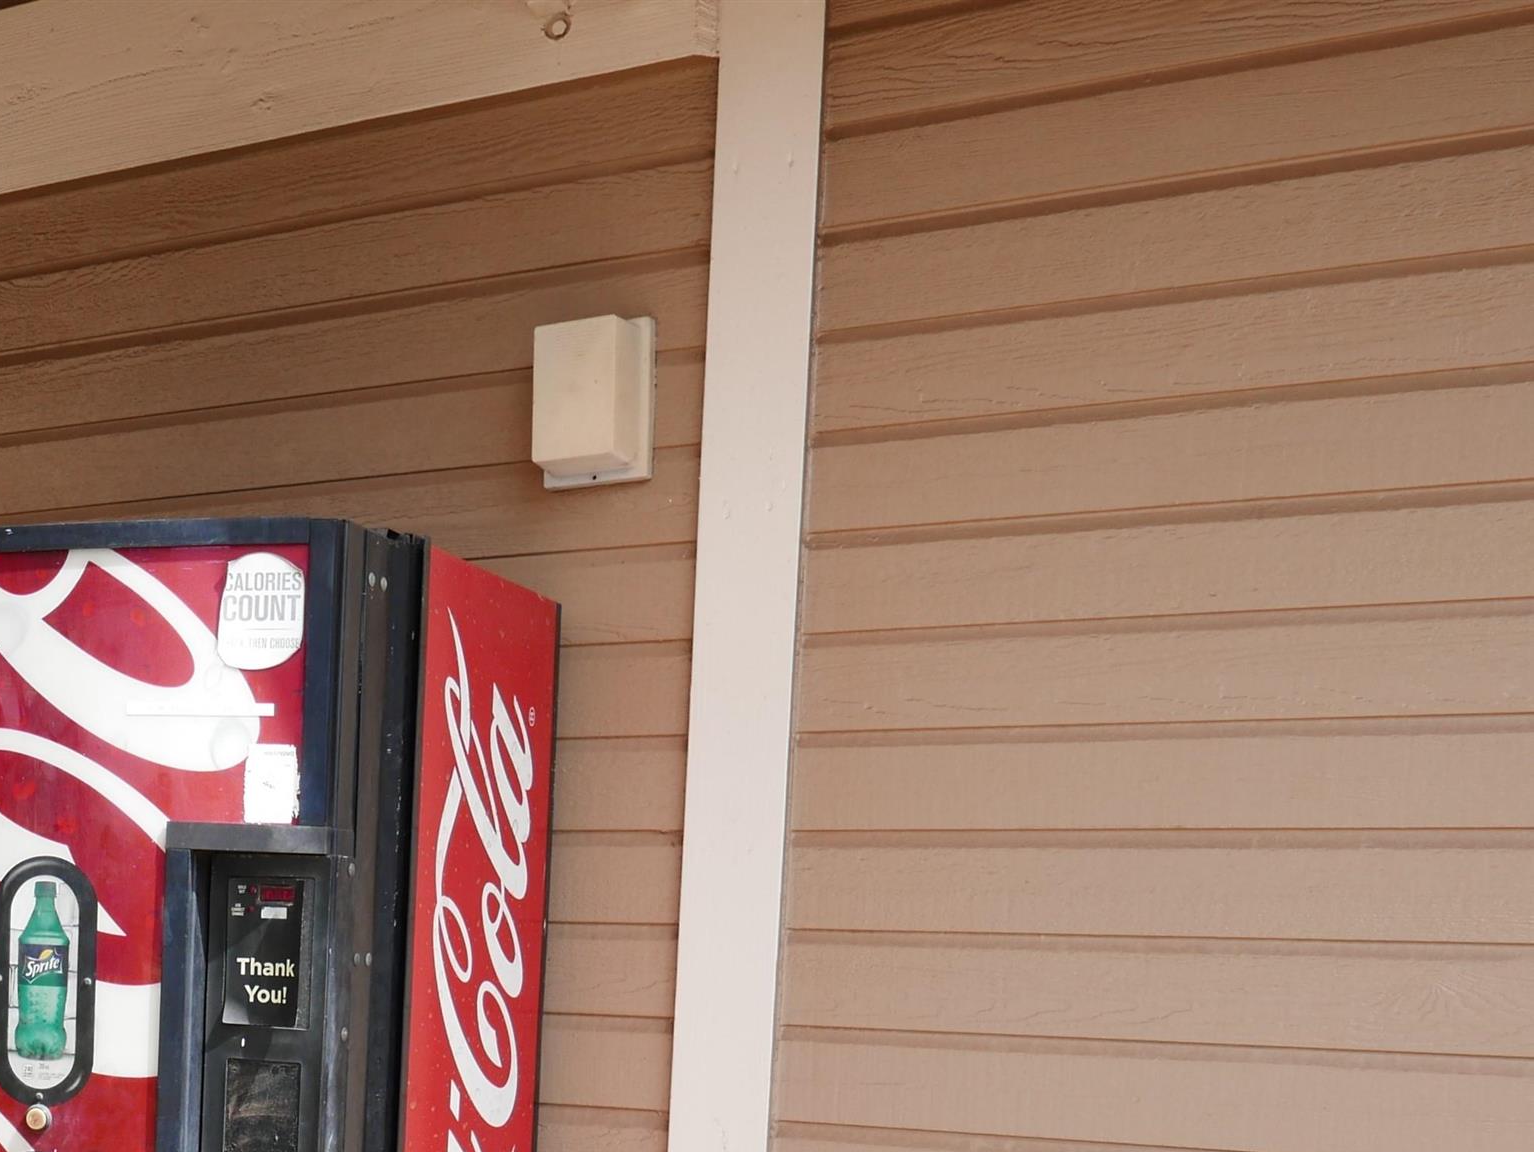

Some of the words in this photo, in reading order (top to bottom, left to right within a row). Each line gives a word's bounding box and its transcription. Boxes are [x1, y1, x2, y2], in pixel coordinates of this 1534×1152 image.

[225, 572, 302, 592] CALORIES
[223, 594, 301, 622] COUNT
[269, 637, 301, 650] CHOOSE
[25, 956, 60, 977] Sprite
[236, 957, 295, 977] Thank
[244, 984, 287, 1004] You!
